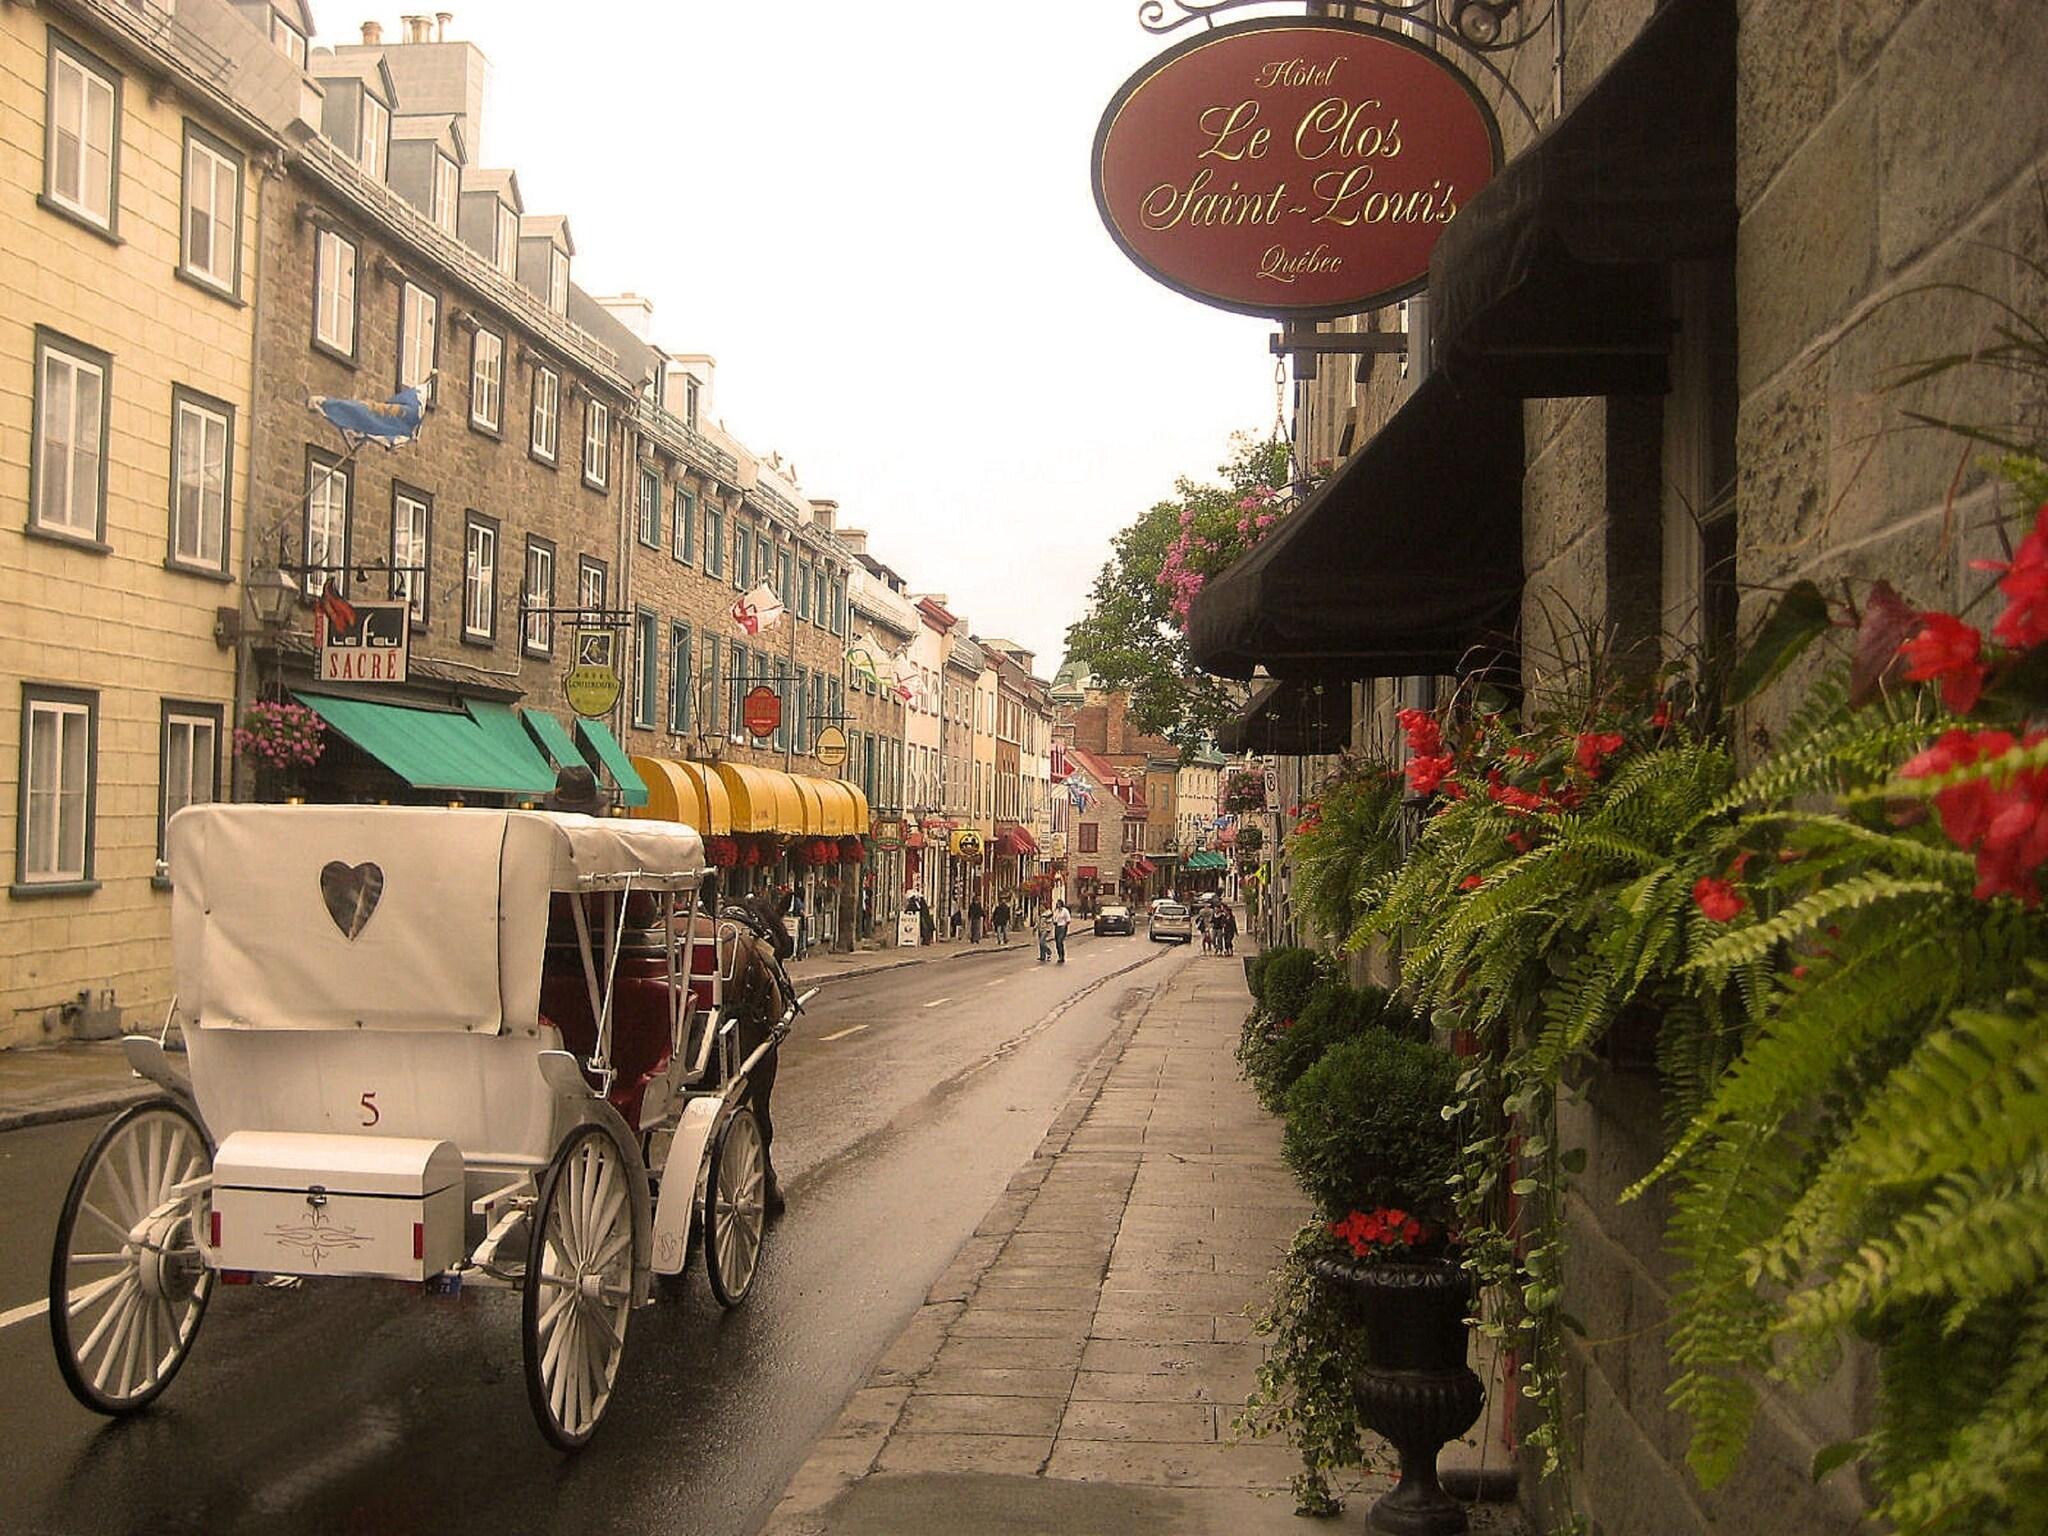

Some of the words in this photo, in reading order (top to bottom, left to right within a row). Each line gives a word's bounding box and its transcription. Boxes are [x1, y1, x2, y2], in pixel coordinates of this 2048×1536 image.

[1254, 56, 1348, 89] Hôtel
[1197, 99, 1271, 161] Le
[1295, 97, 1402, 160] Clos
[1256, 244, 1345, 283] Québec
[329, 649, 397, 680] SACRÉ
[360, 1091, 380, 1127] 5
